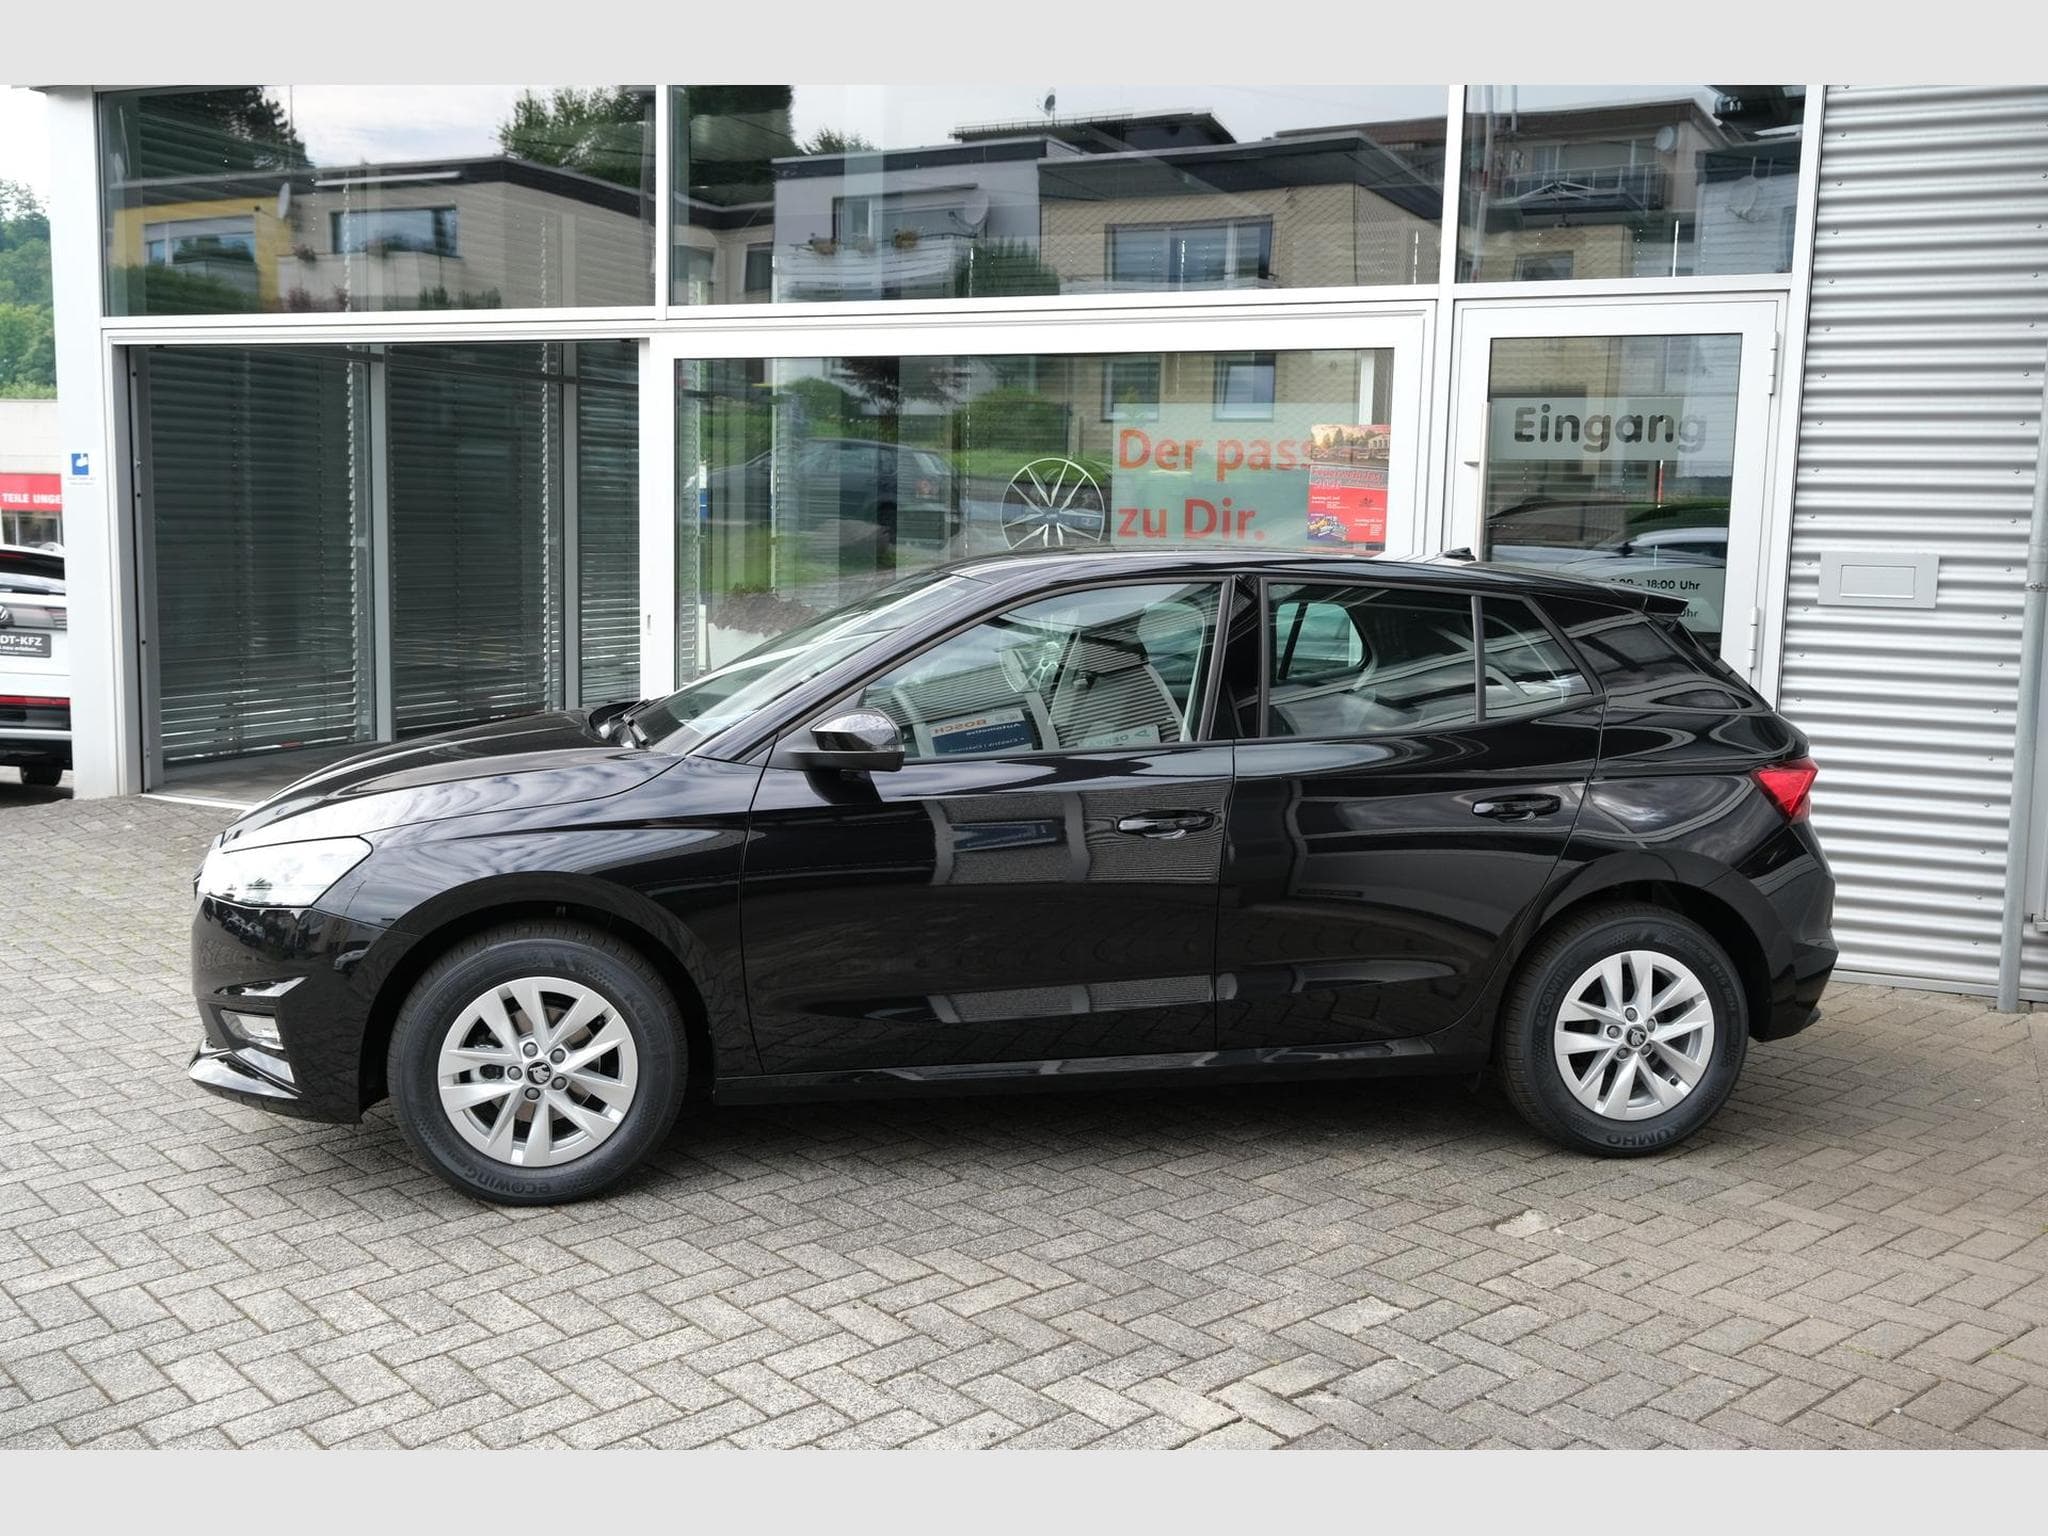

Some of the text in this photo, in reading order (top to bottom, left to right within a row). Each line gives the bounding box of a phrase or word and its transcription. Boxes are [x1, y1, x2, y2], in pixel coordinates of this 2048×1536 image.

[1119, 428, 1203, 470] Der
[1514, 403, 1706, 453] Eingang
[2, 492, 30, 504] TEILE
[1117, 507, 1168, 538] zu
[1184, 497, 1266, 541] Dir.
[1646, 579, 1676, 590] 18:00
[1679, 579, 1701, 590] Uhr
